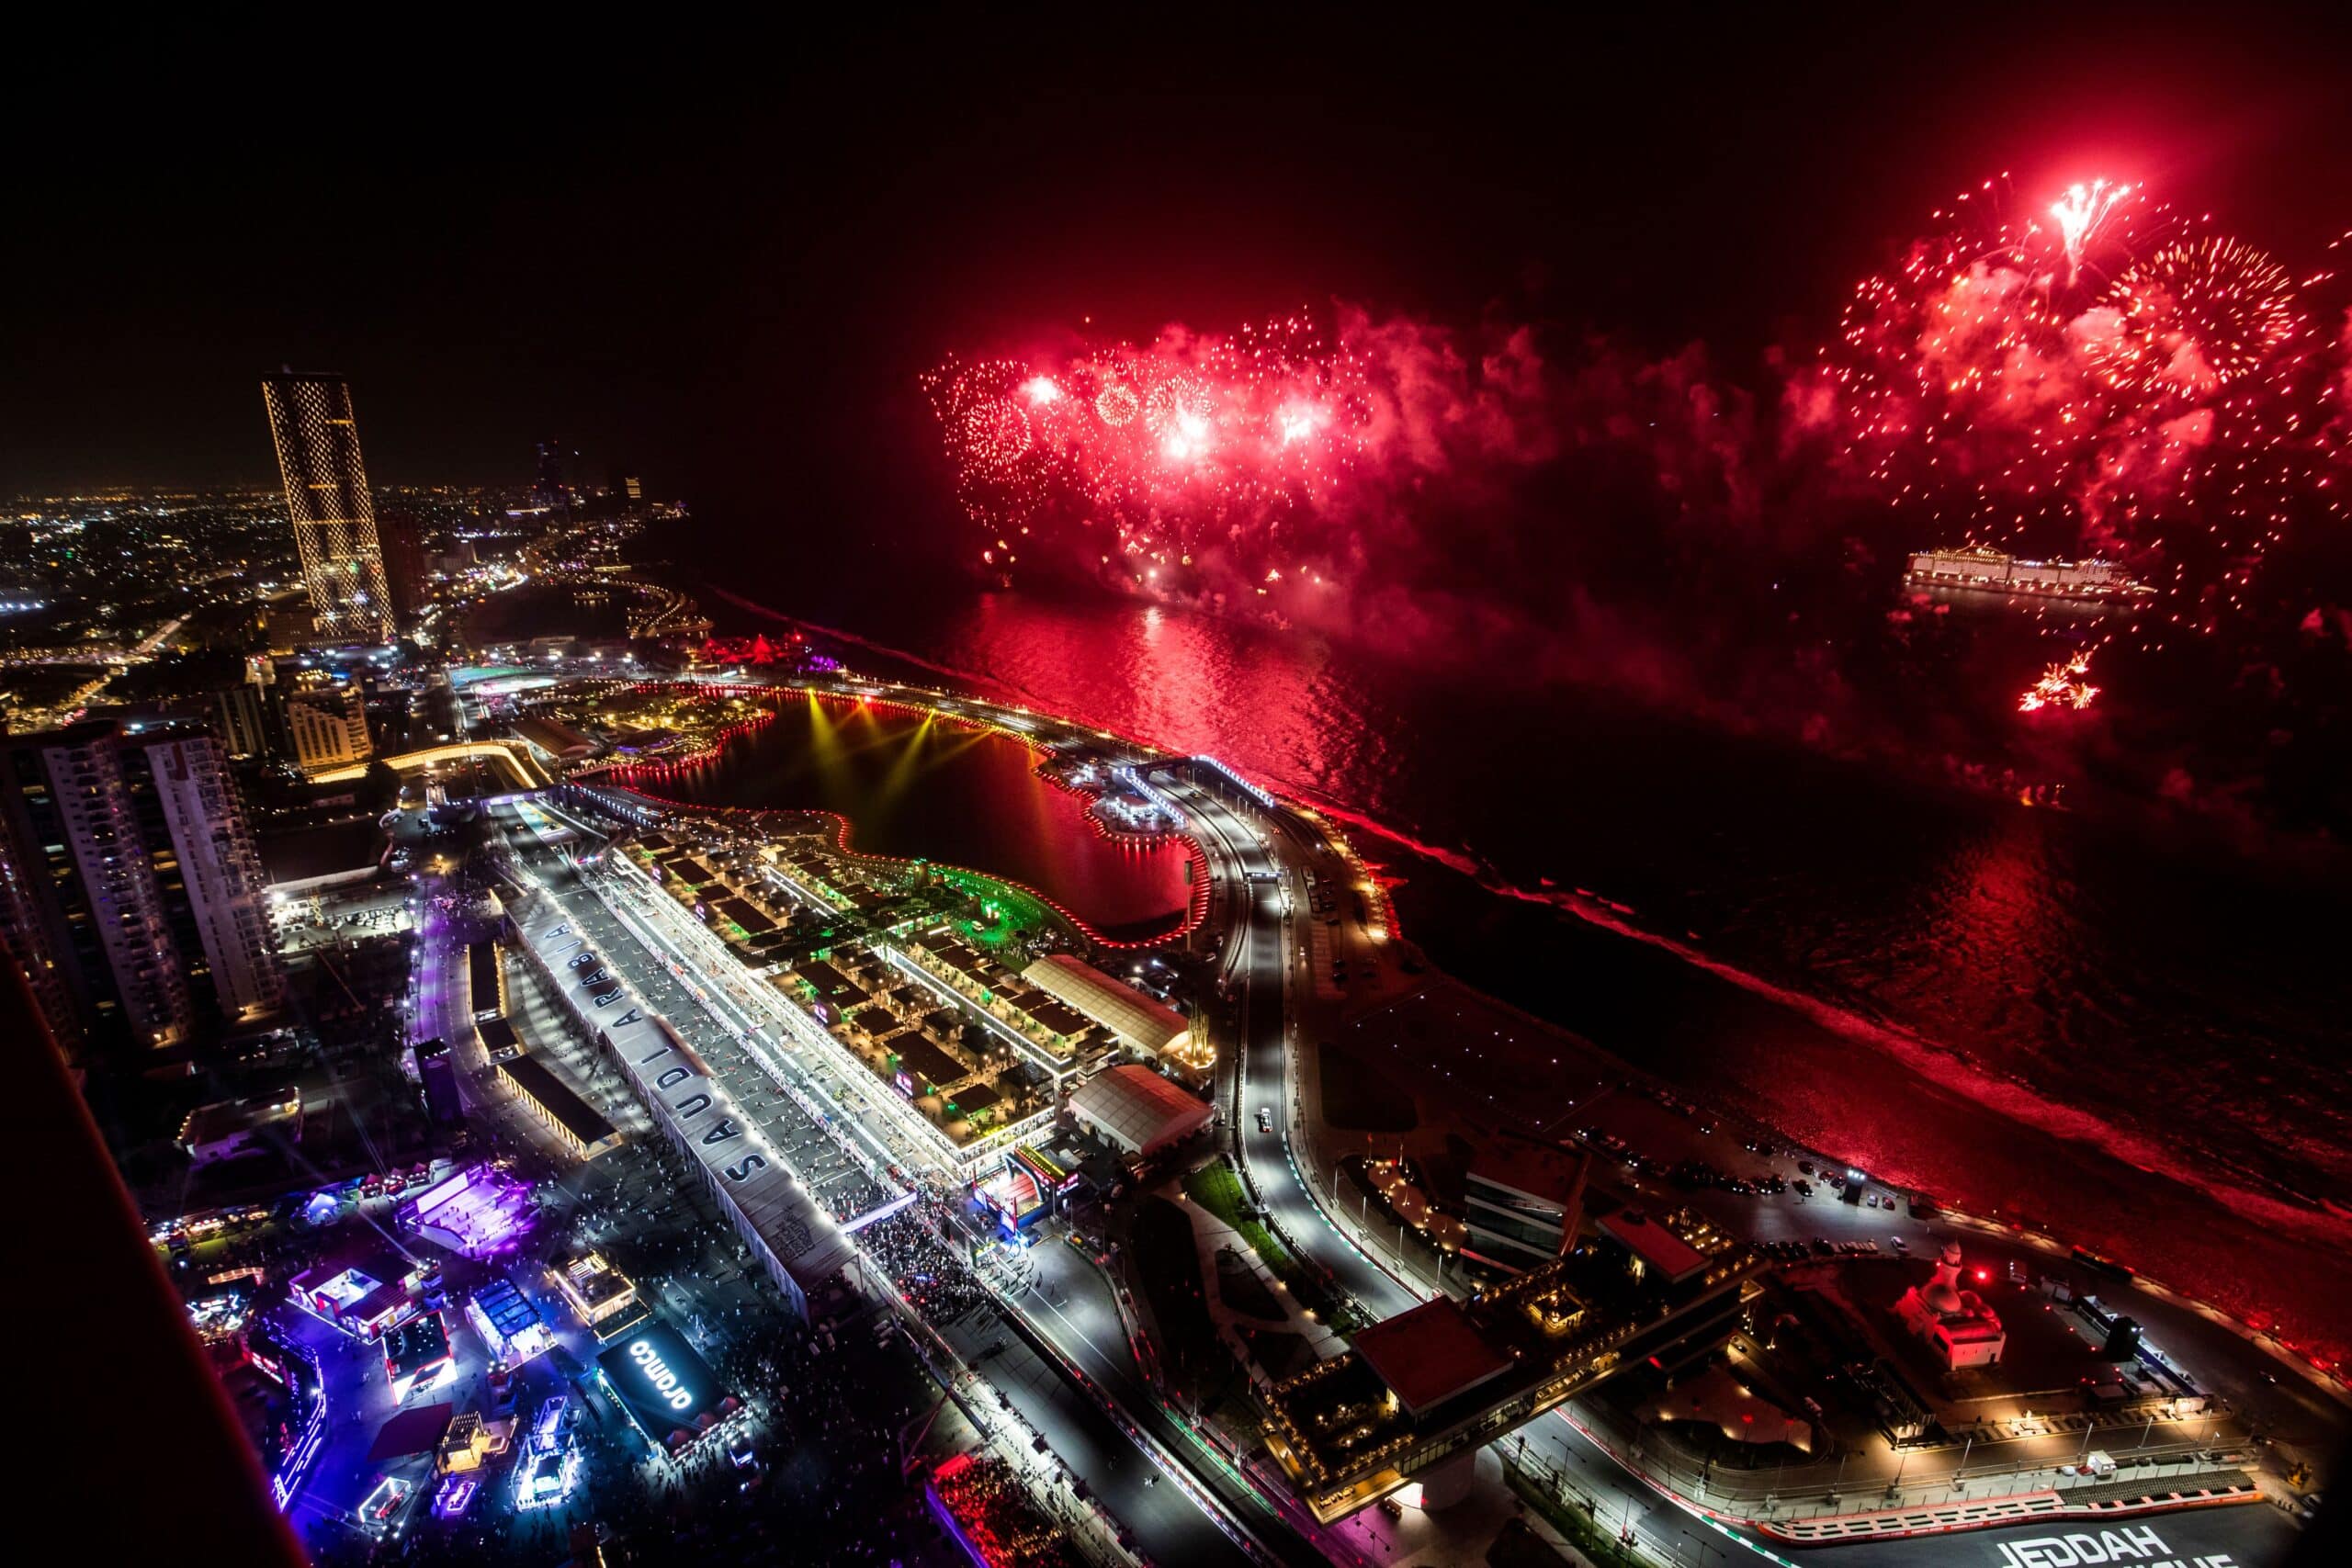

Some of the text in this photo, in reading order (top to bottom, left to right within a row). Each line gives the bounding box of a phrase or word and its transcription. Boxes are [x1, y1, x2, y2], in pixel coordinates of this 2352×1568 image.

[544, 922, 768, 1183] SAUDI ARABIA
[629, 1340, 693, 1409] aramco
[1996, 1525, 2174, 1568] JEDDAH
